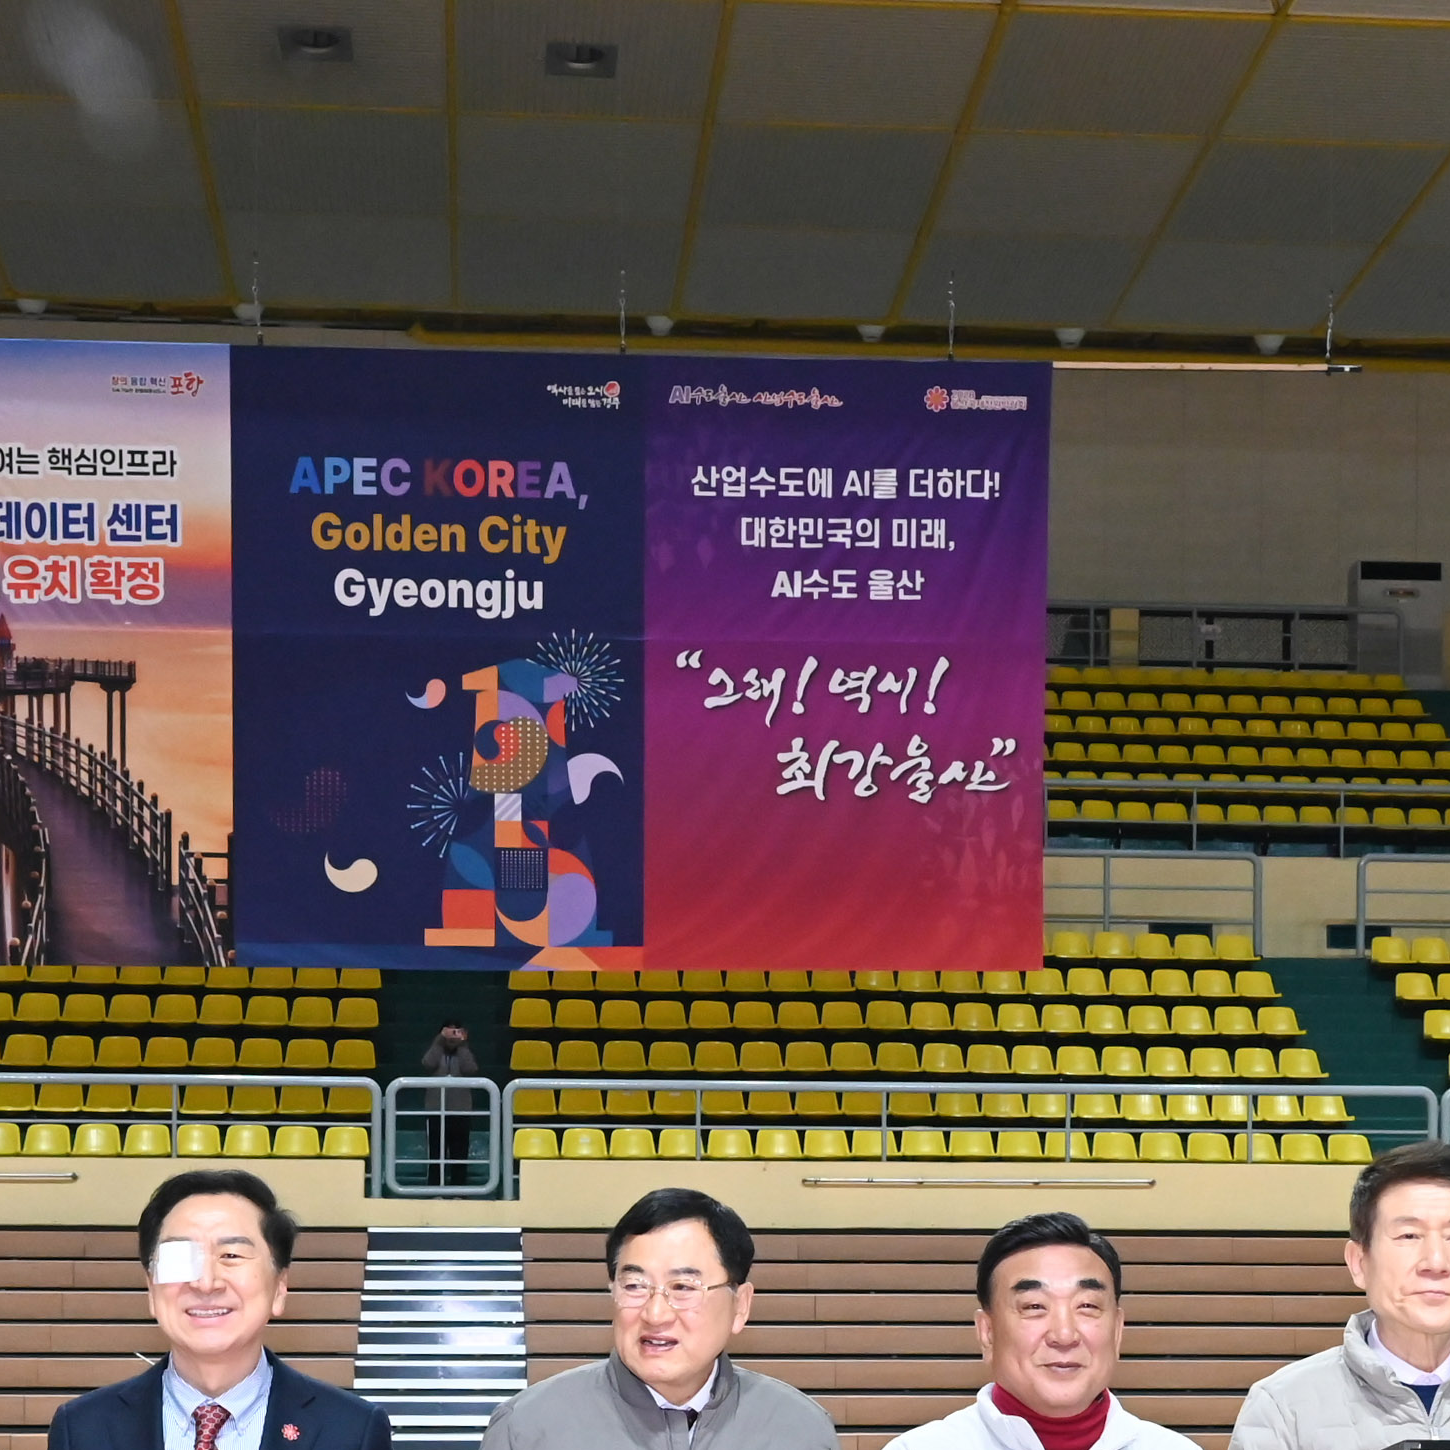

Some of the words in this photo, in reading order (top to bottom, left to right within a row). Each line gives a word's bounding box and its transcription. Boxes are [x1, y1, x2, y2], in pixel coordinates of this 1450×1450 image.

[169, 371, 204, 397] 포항
[47, 448, 177, 477] 핵심인프라
[289, 456, 411, 496] APEC
[424, 458, 589, 510] KOREA,
[691, 466, 833, 498] 산업수도에
[843, 468, 897, 499] AI를
[909, 468, 1000, 499] 더하다!
[107, 503, 179, 542] 센터
[311, 512, 466, 552] Golden
[479, 514, 567, 564] City
[741, 517, 880, 549] 대한민국의
[892, 518, 955, 551] 미래,
[7, 559, 77, 600] 유치
[89, 560, 161, 601] 확정
[334, 568, 544, 619] Gyeongju
[771, 570, 857, 600] AI수도
[868, 570, 924, 600] 울산
[829, 656, 949, 714] 역시!
